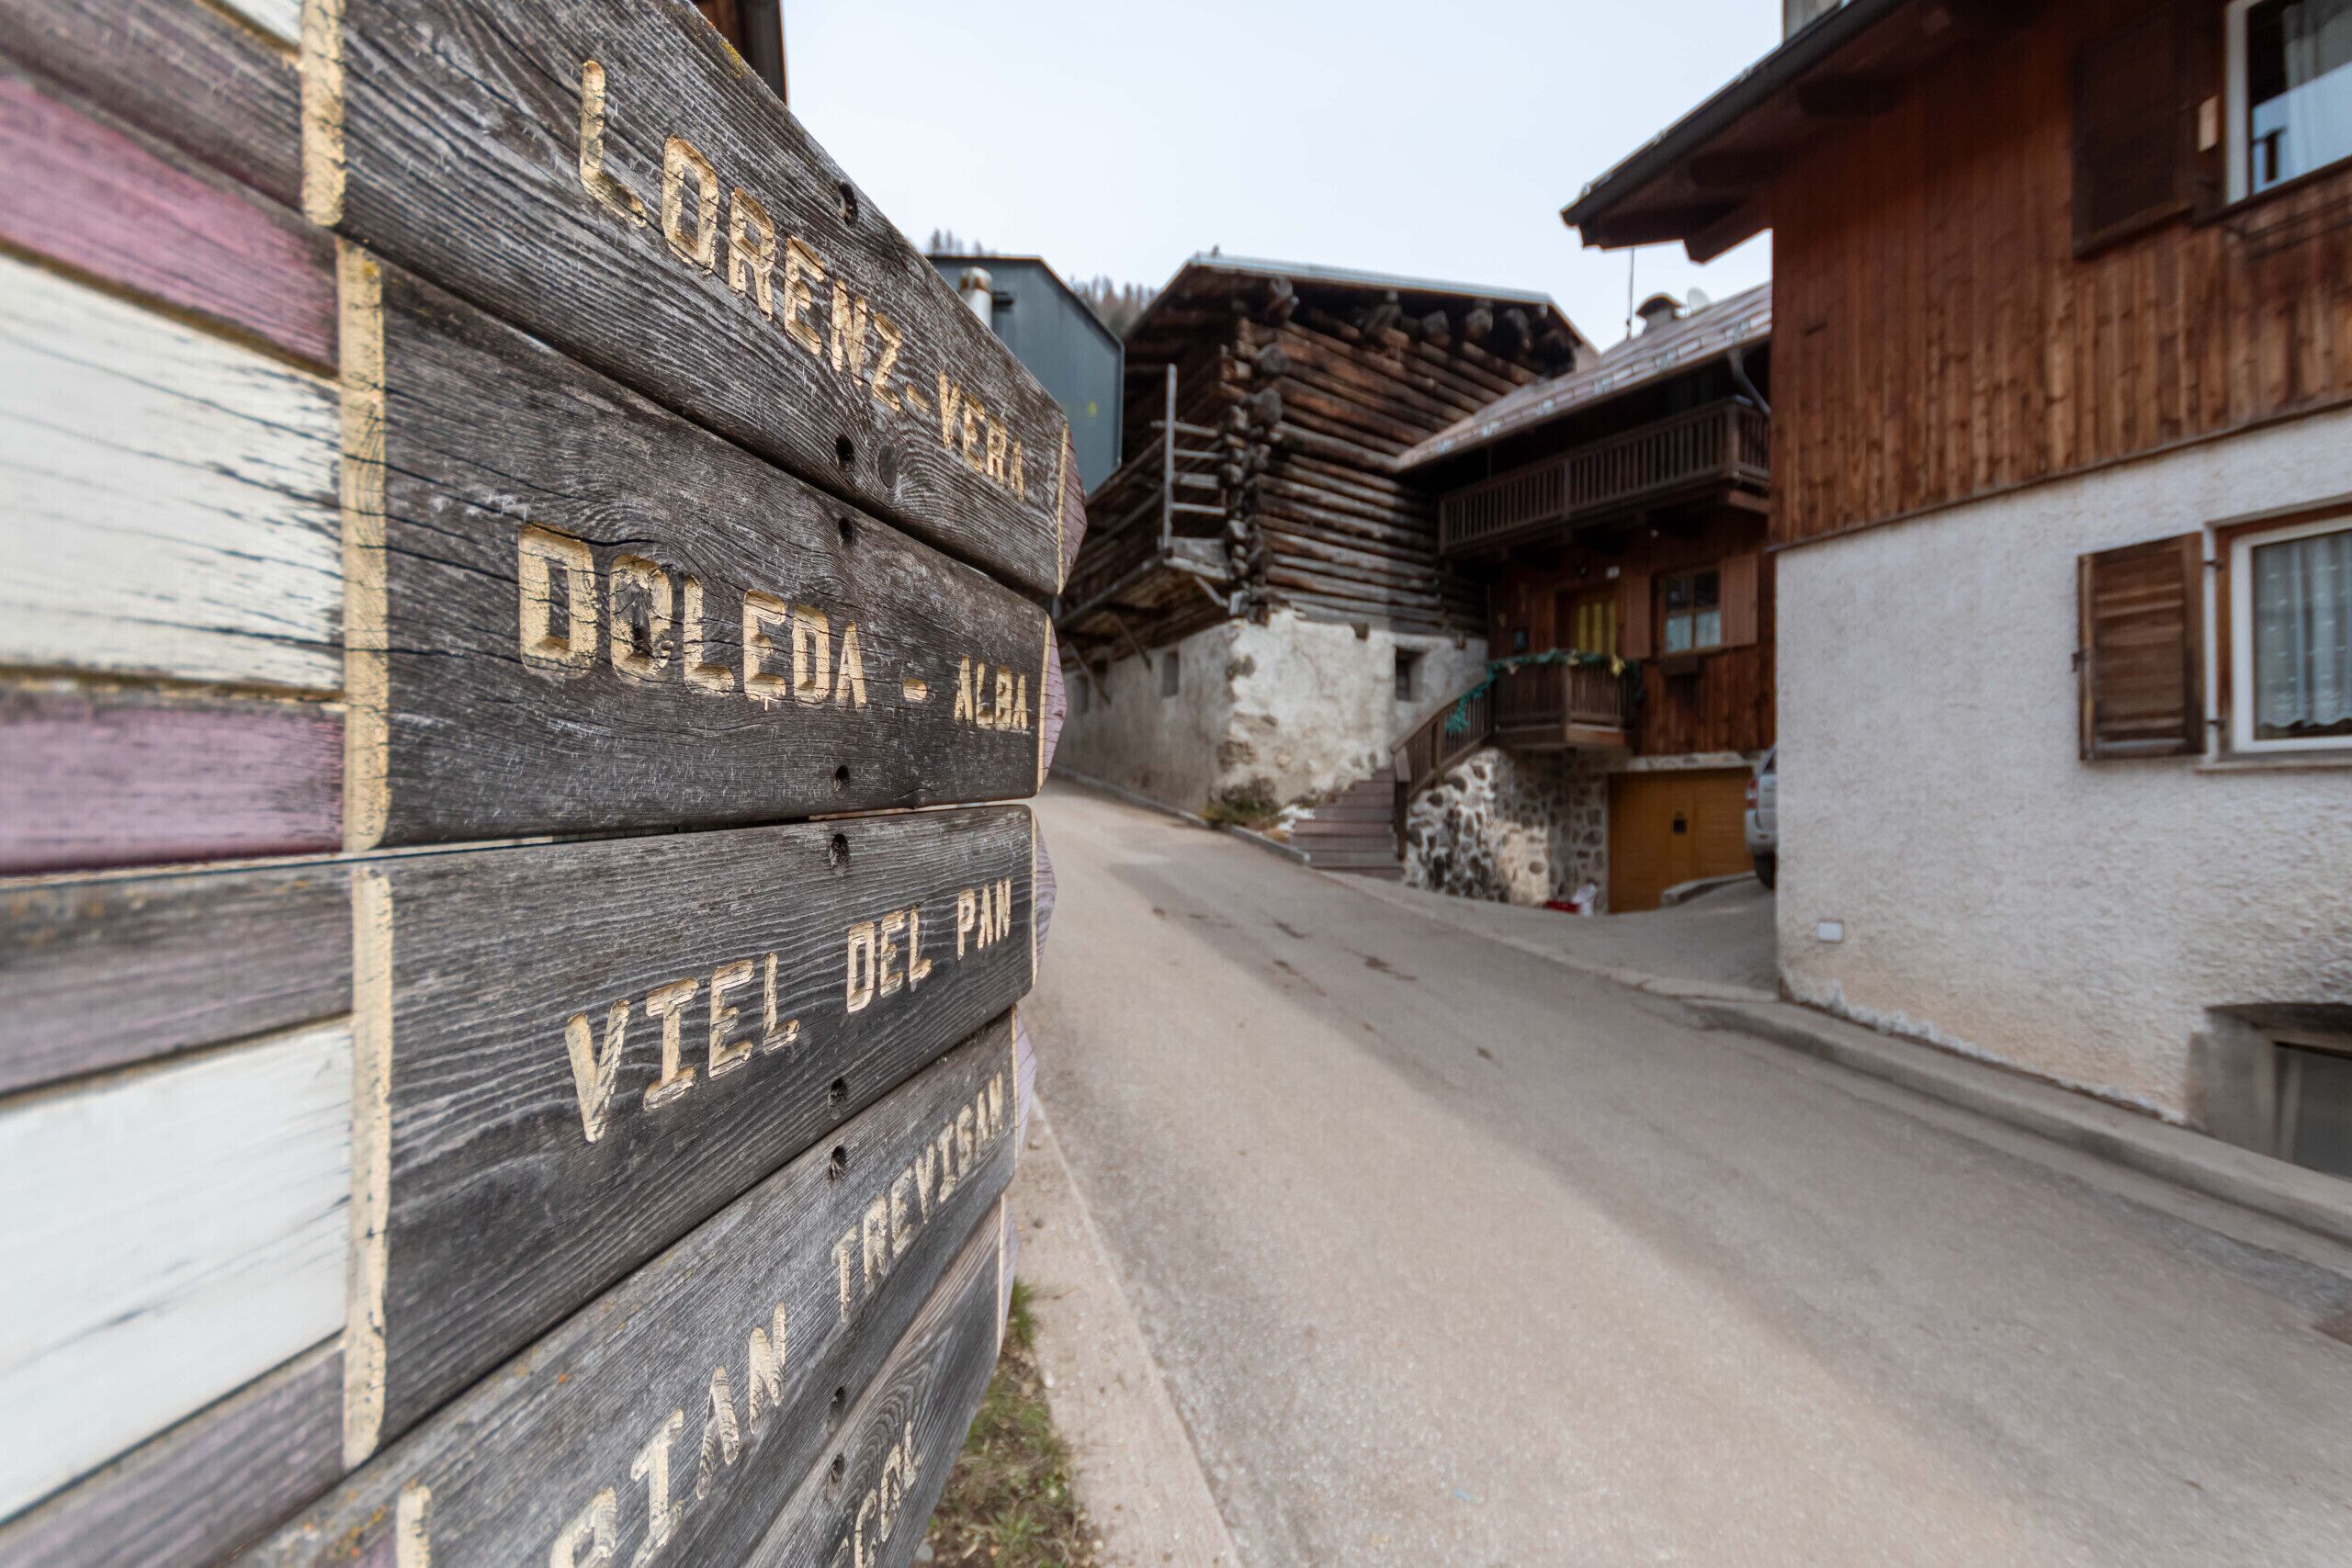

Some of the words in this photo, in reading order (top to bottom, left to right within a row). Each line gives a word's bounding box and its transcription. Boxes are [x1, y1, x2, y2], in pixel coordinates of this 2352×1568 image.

[519, 522, 867, 712] DOLEDA
[955, 653, 1028, 731] ALBA
[564, 951, 799, 1145] VIEL
[846, 905, 933, 1013] DEL
[956, 877, 1011, 960] PAN
[831, 1069, 1004, 1323] TREVISAN
